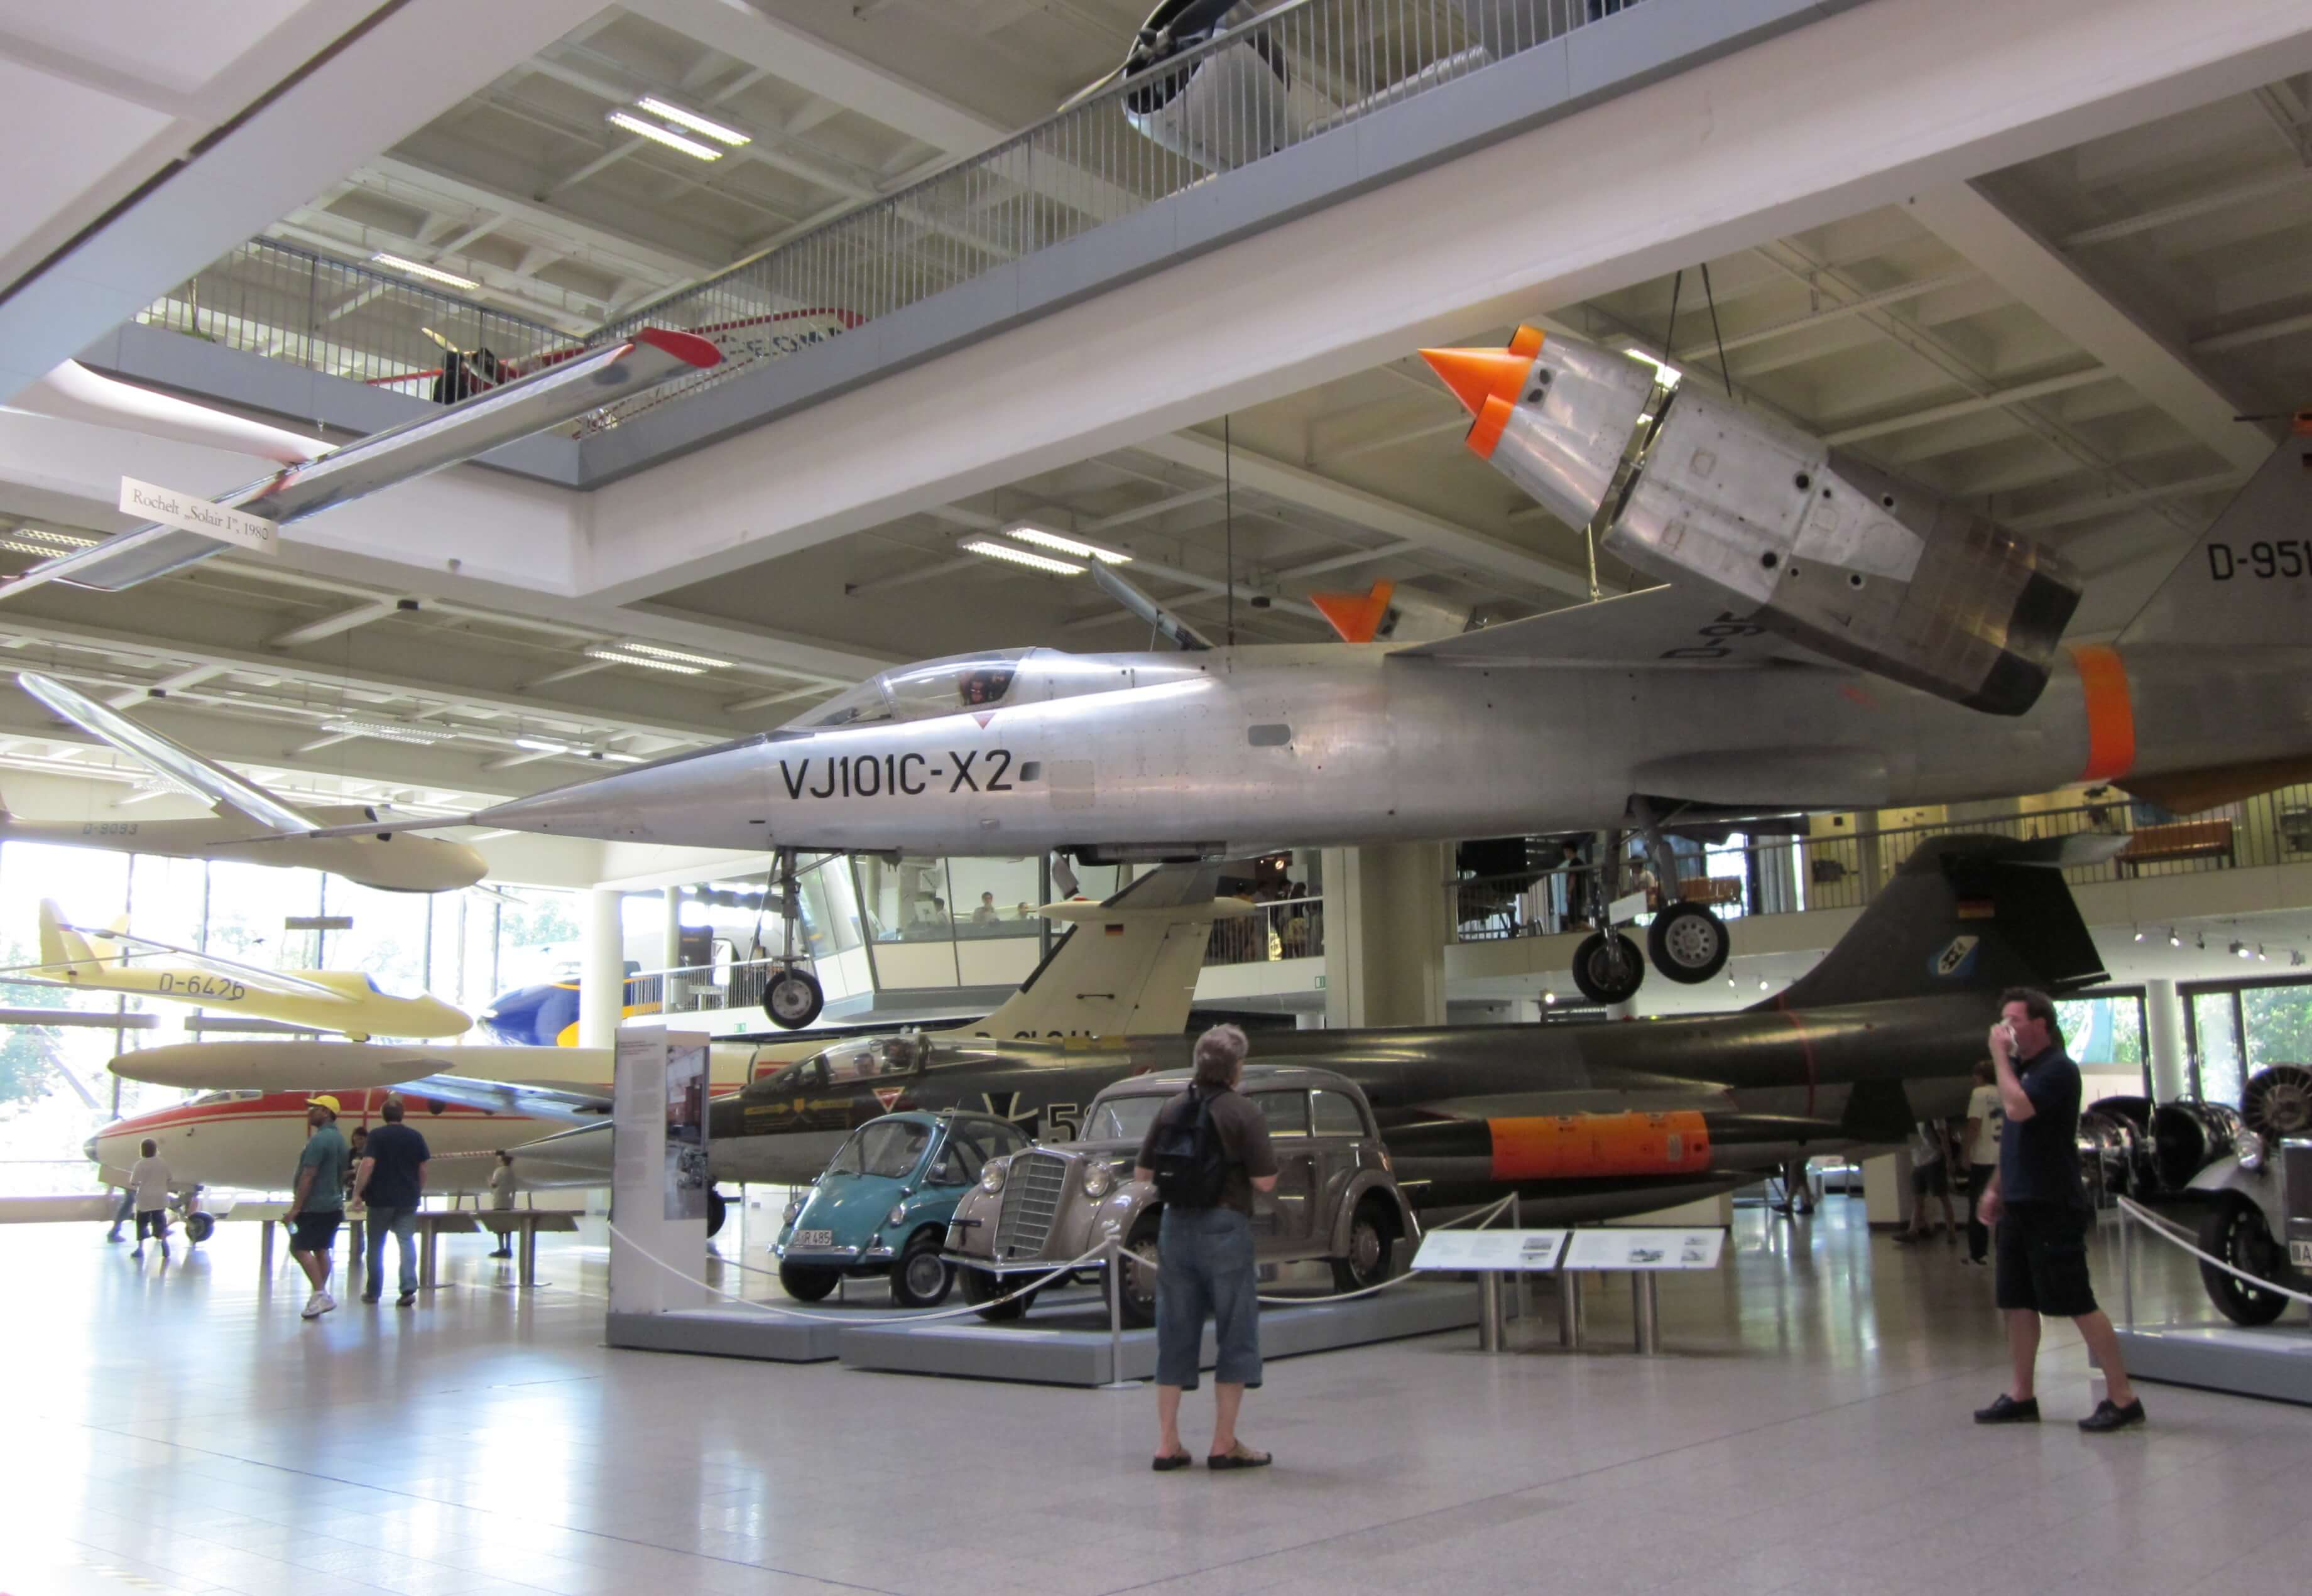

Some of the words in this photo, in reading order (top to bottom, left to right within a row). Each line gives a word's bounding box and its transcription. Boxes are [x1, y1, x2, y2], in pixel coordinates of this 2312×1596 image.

[133, 487, 179, 515] Rochelt
[244, 522, 270, 541] 1980
[780, 749, 1013, 800] VJ101C-X2
[159, 972, 246, 1001] D-6426
